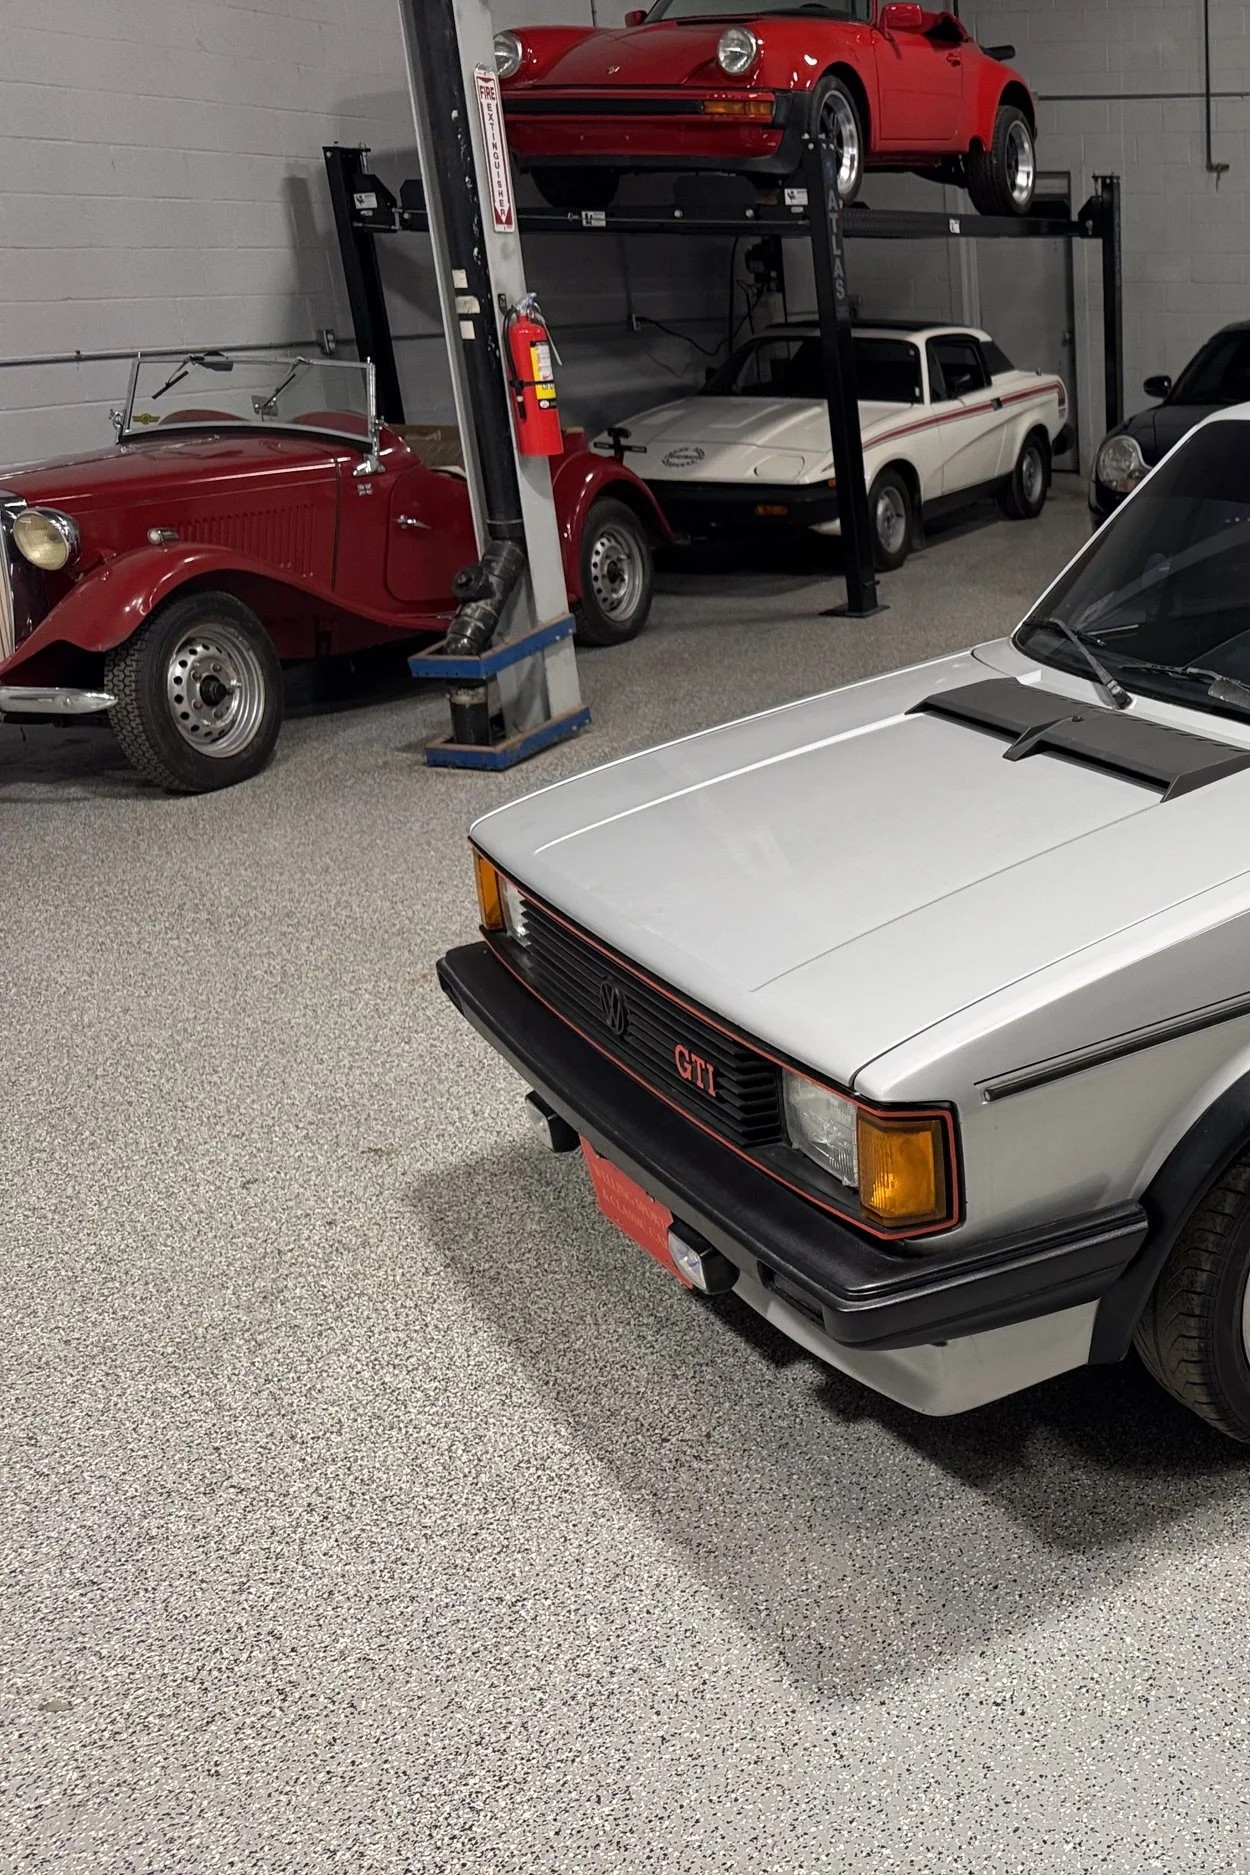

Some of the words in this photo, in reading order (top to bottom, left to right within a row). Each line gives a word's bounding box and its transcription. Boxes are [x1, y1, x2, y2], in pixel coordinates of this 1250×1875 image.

[479, 85, 496, 101] FIRE
[487, 102, 506, 216] EXTINGUISHER
[827, 189, 846, 300] ATLAS
[675, 1044, 716, 1097] GTI
